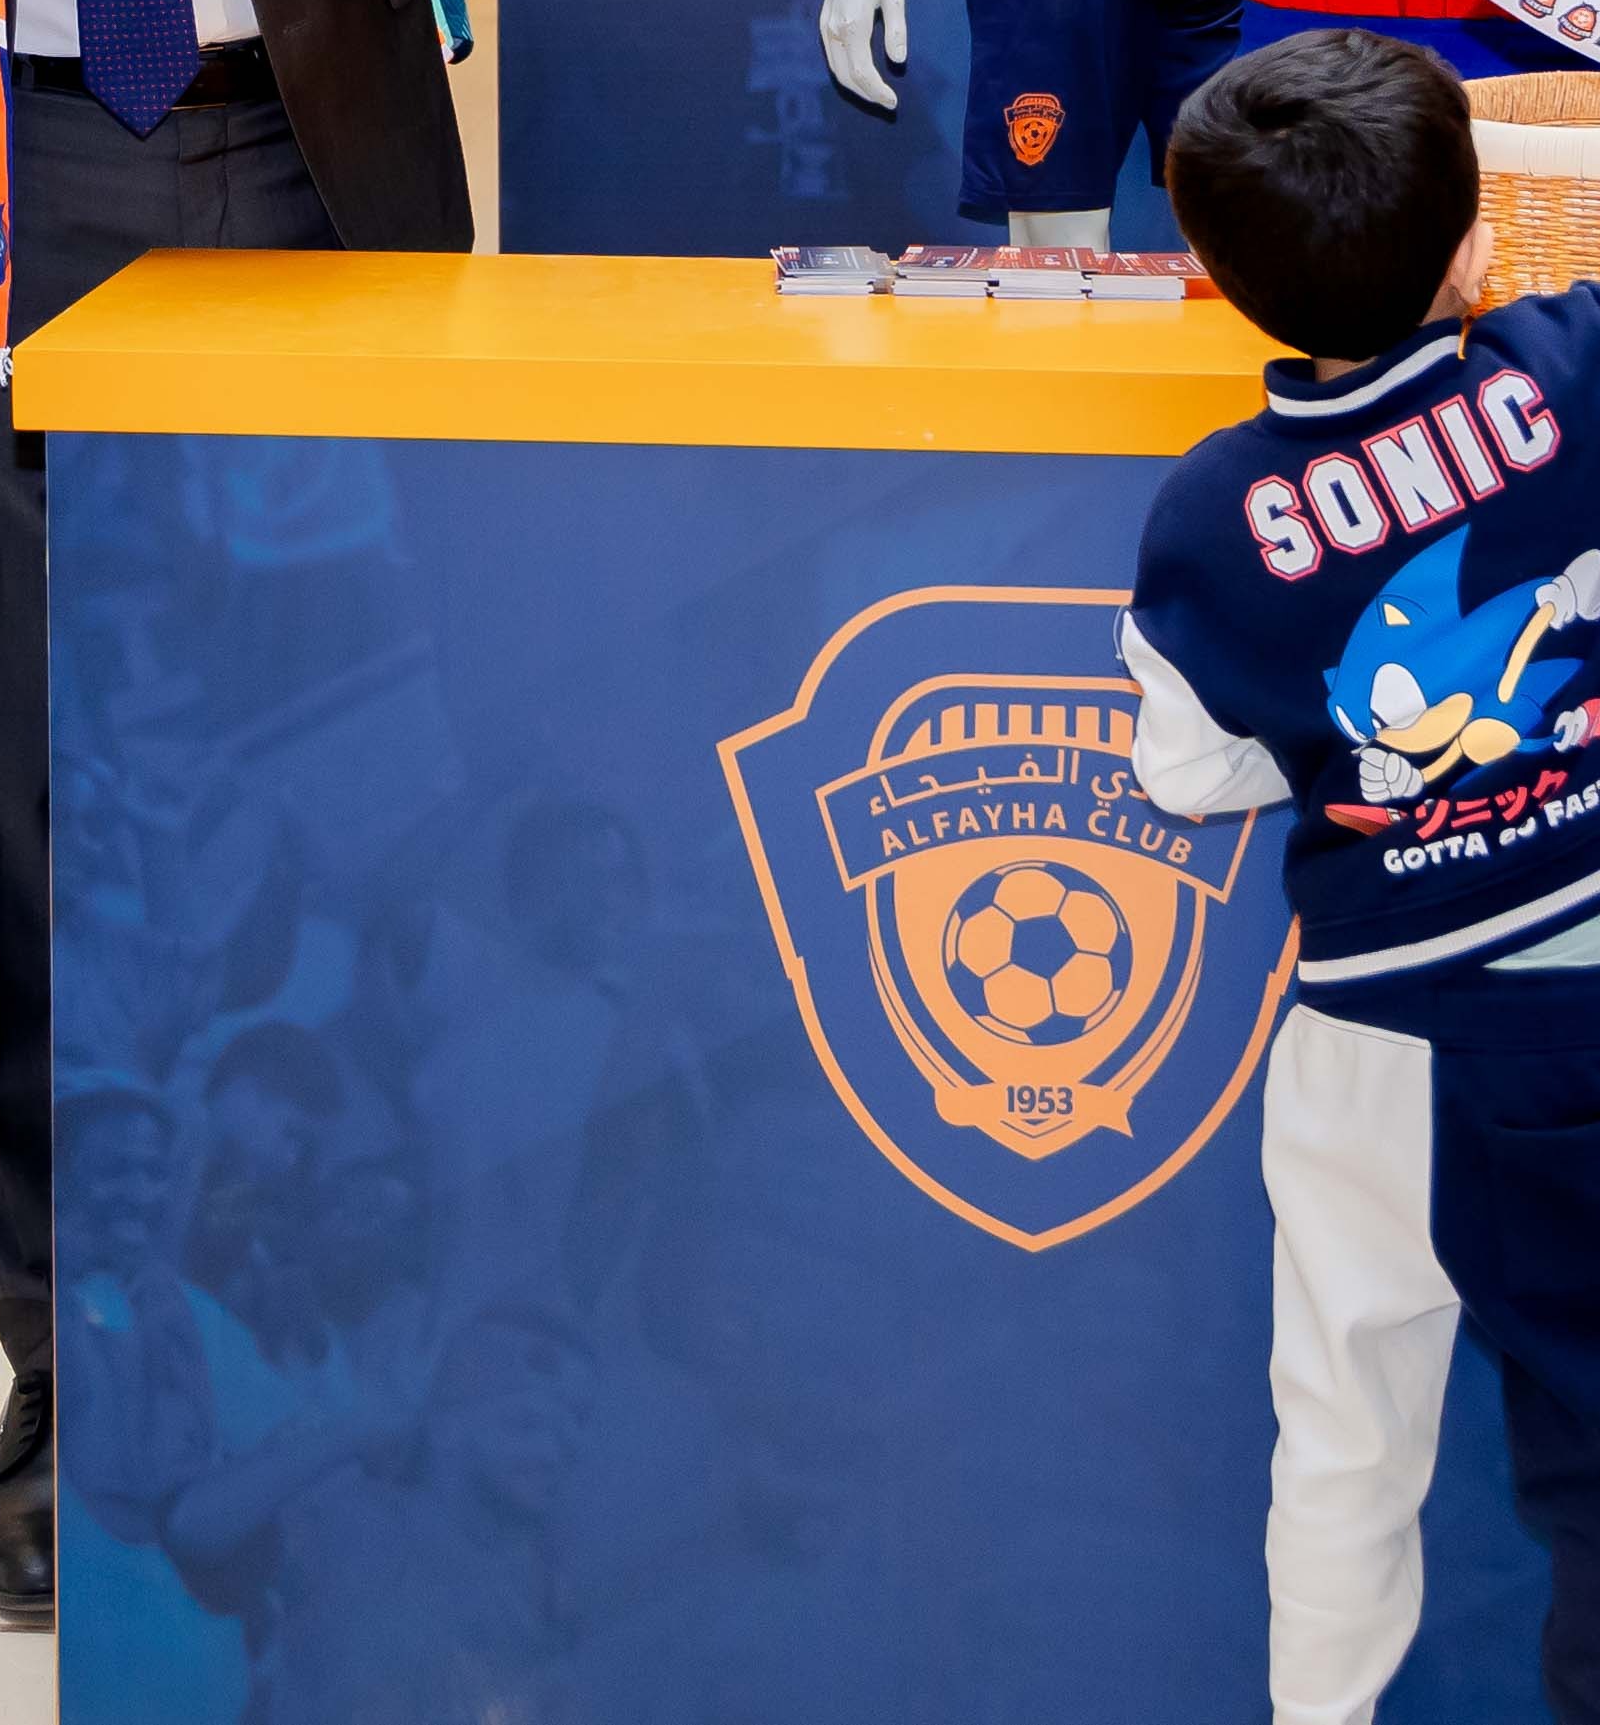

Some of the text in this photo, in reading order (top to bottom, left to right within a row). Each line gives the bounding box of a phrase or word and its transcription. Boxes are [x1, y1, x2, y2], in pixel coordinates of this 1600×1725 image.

[1244, 369, 1561, 581] SONIC
[870, 749, 1080, 816] الفيحاء
[1415, 770, 1568, 840] ソニック
[881, 803, 1193, 864] ALFAYHA CLUB
[1383, 831, 1490, 874] GOTTA
[1005, 1084, 1074, 1115] 1953
